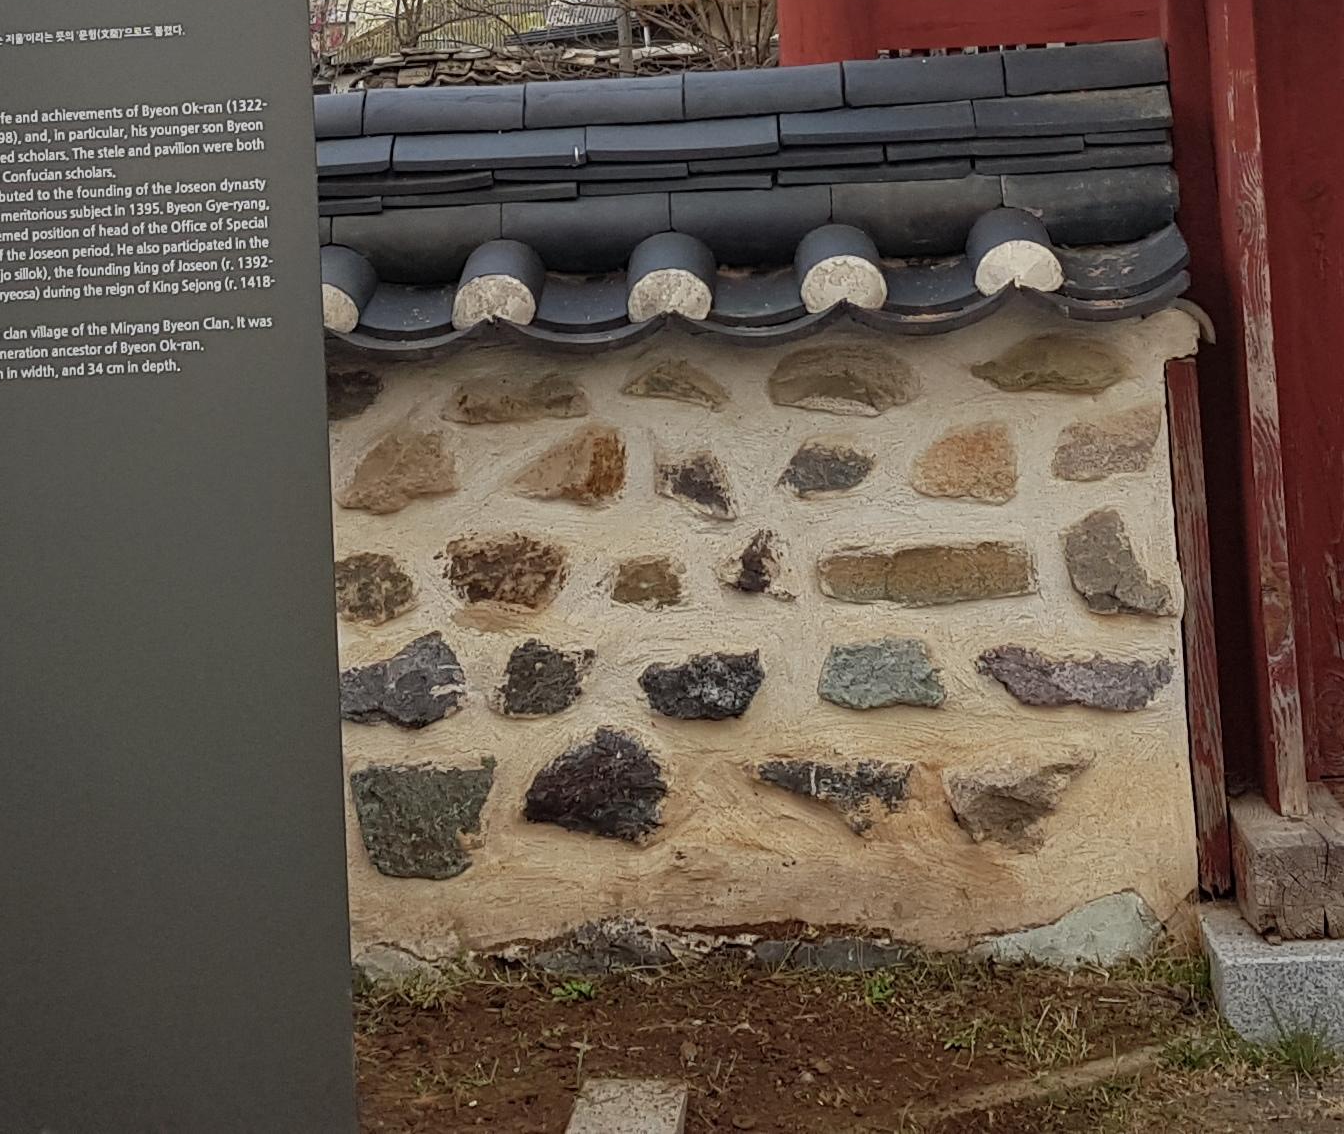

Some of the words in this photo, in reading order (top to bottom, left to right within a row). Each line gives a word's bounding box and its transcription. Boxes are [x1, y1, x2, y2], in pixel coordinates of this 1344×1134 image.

[14, 109, 38, 123] and
[41, 107, 123, 122] achievements
[125, 104, 138, 117] of
[141, 104, 178, 118] Byeon
[181, 101, 222, 114] Ok-ran
[226, 98, 267, 114] (1322-
[36, 189, 50, 200] to
[52, 186, 73, 199] the
[76, 184, 132, 198] founding
[135, 182, 148, 195] of
[151, 181, 171, 194] the
[174, 181, 216, 193] Joseon
[219, 177, 266, 192] dynasty
[6, 247, 26, 261] the
[28, 247, 69, 259] Joseon
[72, 242, 113, 259] period.
[116, 243, 133, 255] He
[136, 241, 159, 254] also
[162, 236, 232, 255] participated
[234, 236, 246, 249] in
[248, 235, 269, 248] the
[6, 366, 17, 379] in
[20, 364, 58, 378] width,
[61, 362, 84, 376] and
[87, 362, 103, 375] 34
[106, 363, 124, 374] cm
[127, 360, 138, 373] in
[141, 358, 180, 373] depth.
